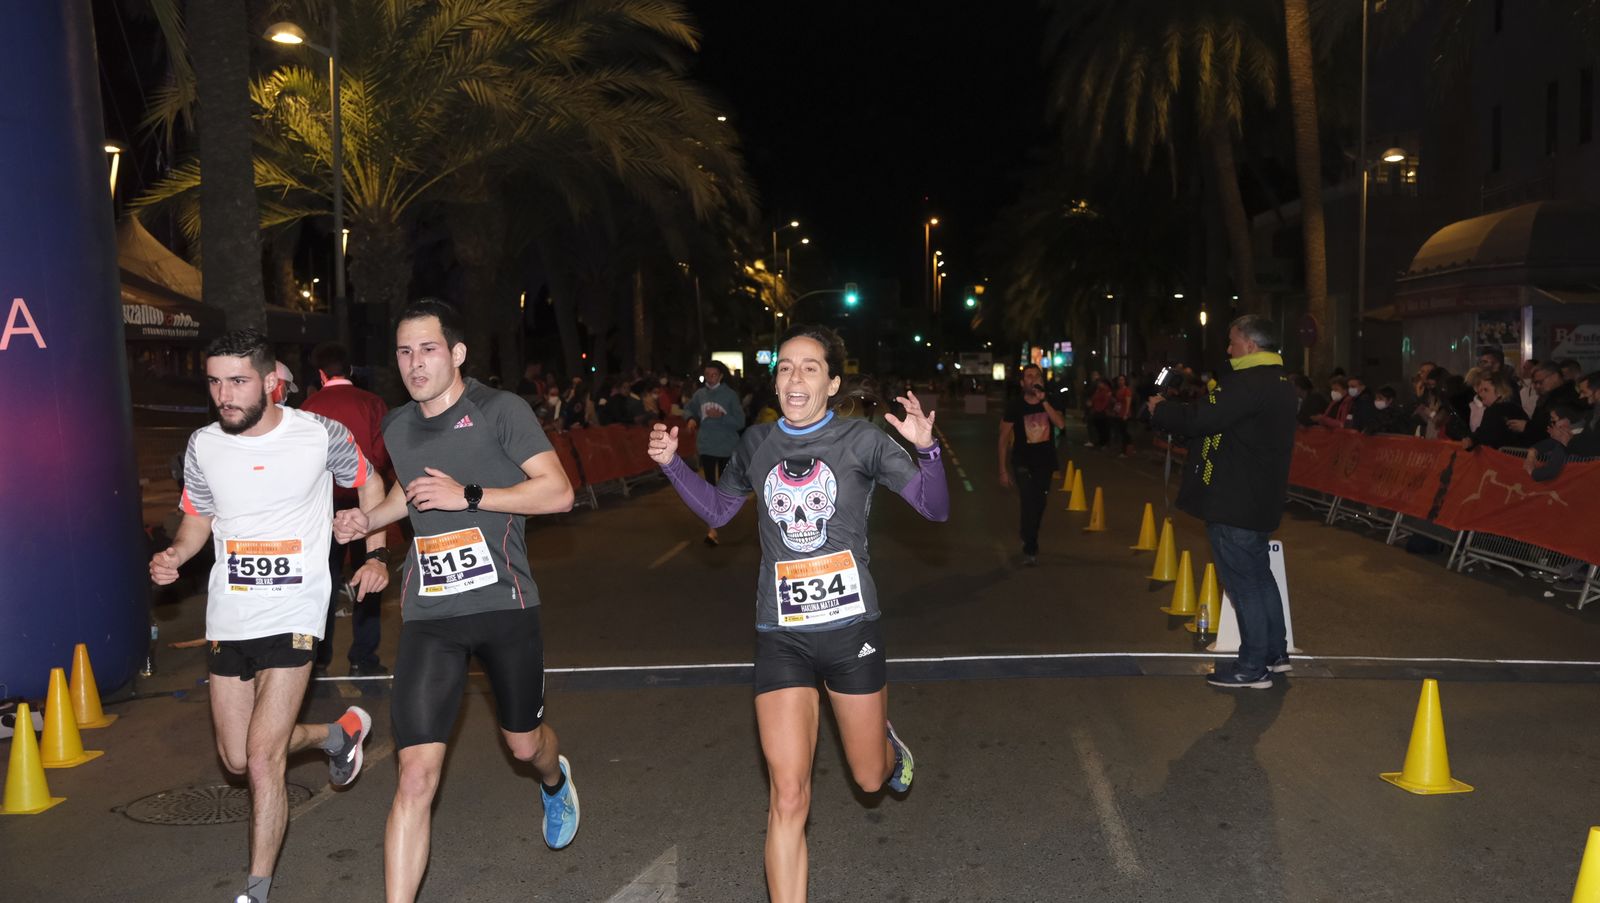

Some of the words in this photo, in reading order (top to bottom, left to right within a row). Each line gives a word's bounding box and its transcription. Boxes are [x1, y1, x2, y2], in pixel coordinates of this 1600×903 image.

[0, 298, 47, 350] A
[240, 557, 290, 576] 598
[429, 547, 477, 575] 515
[792, 573, 846, 603] 534
[820, 599, 840, 609] MATATA
